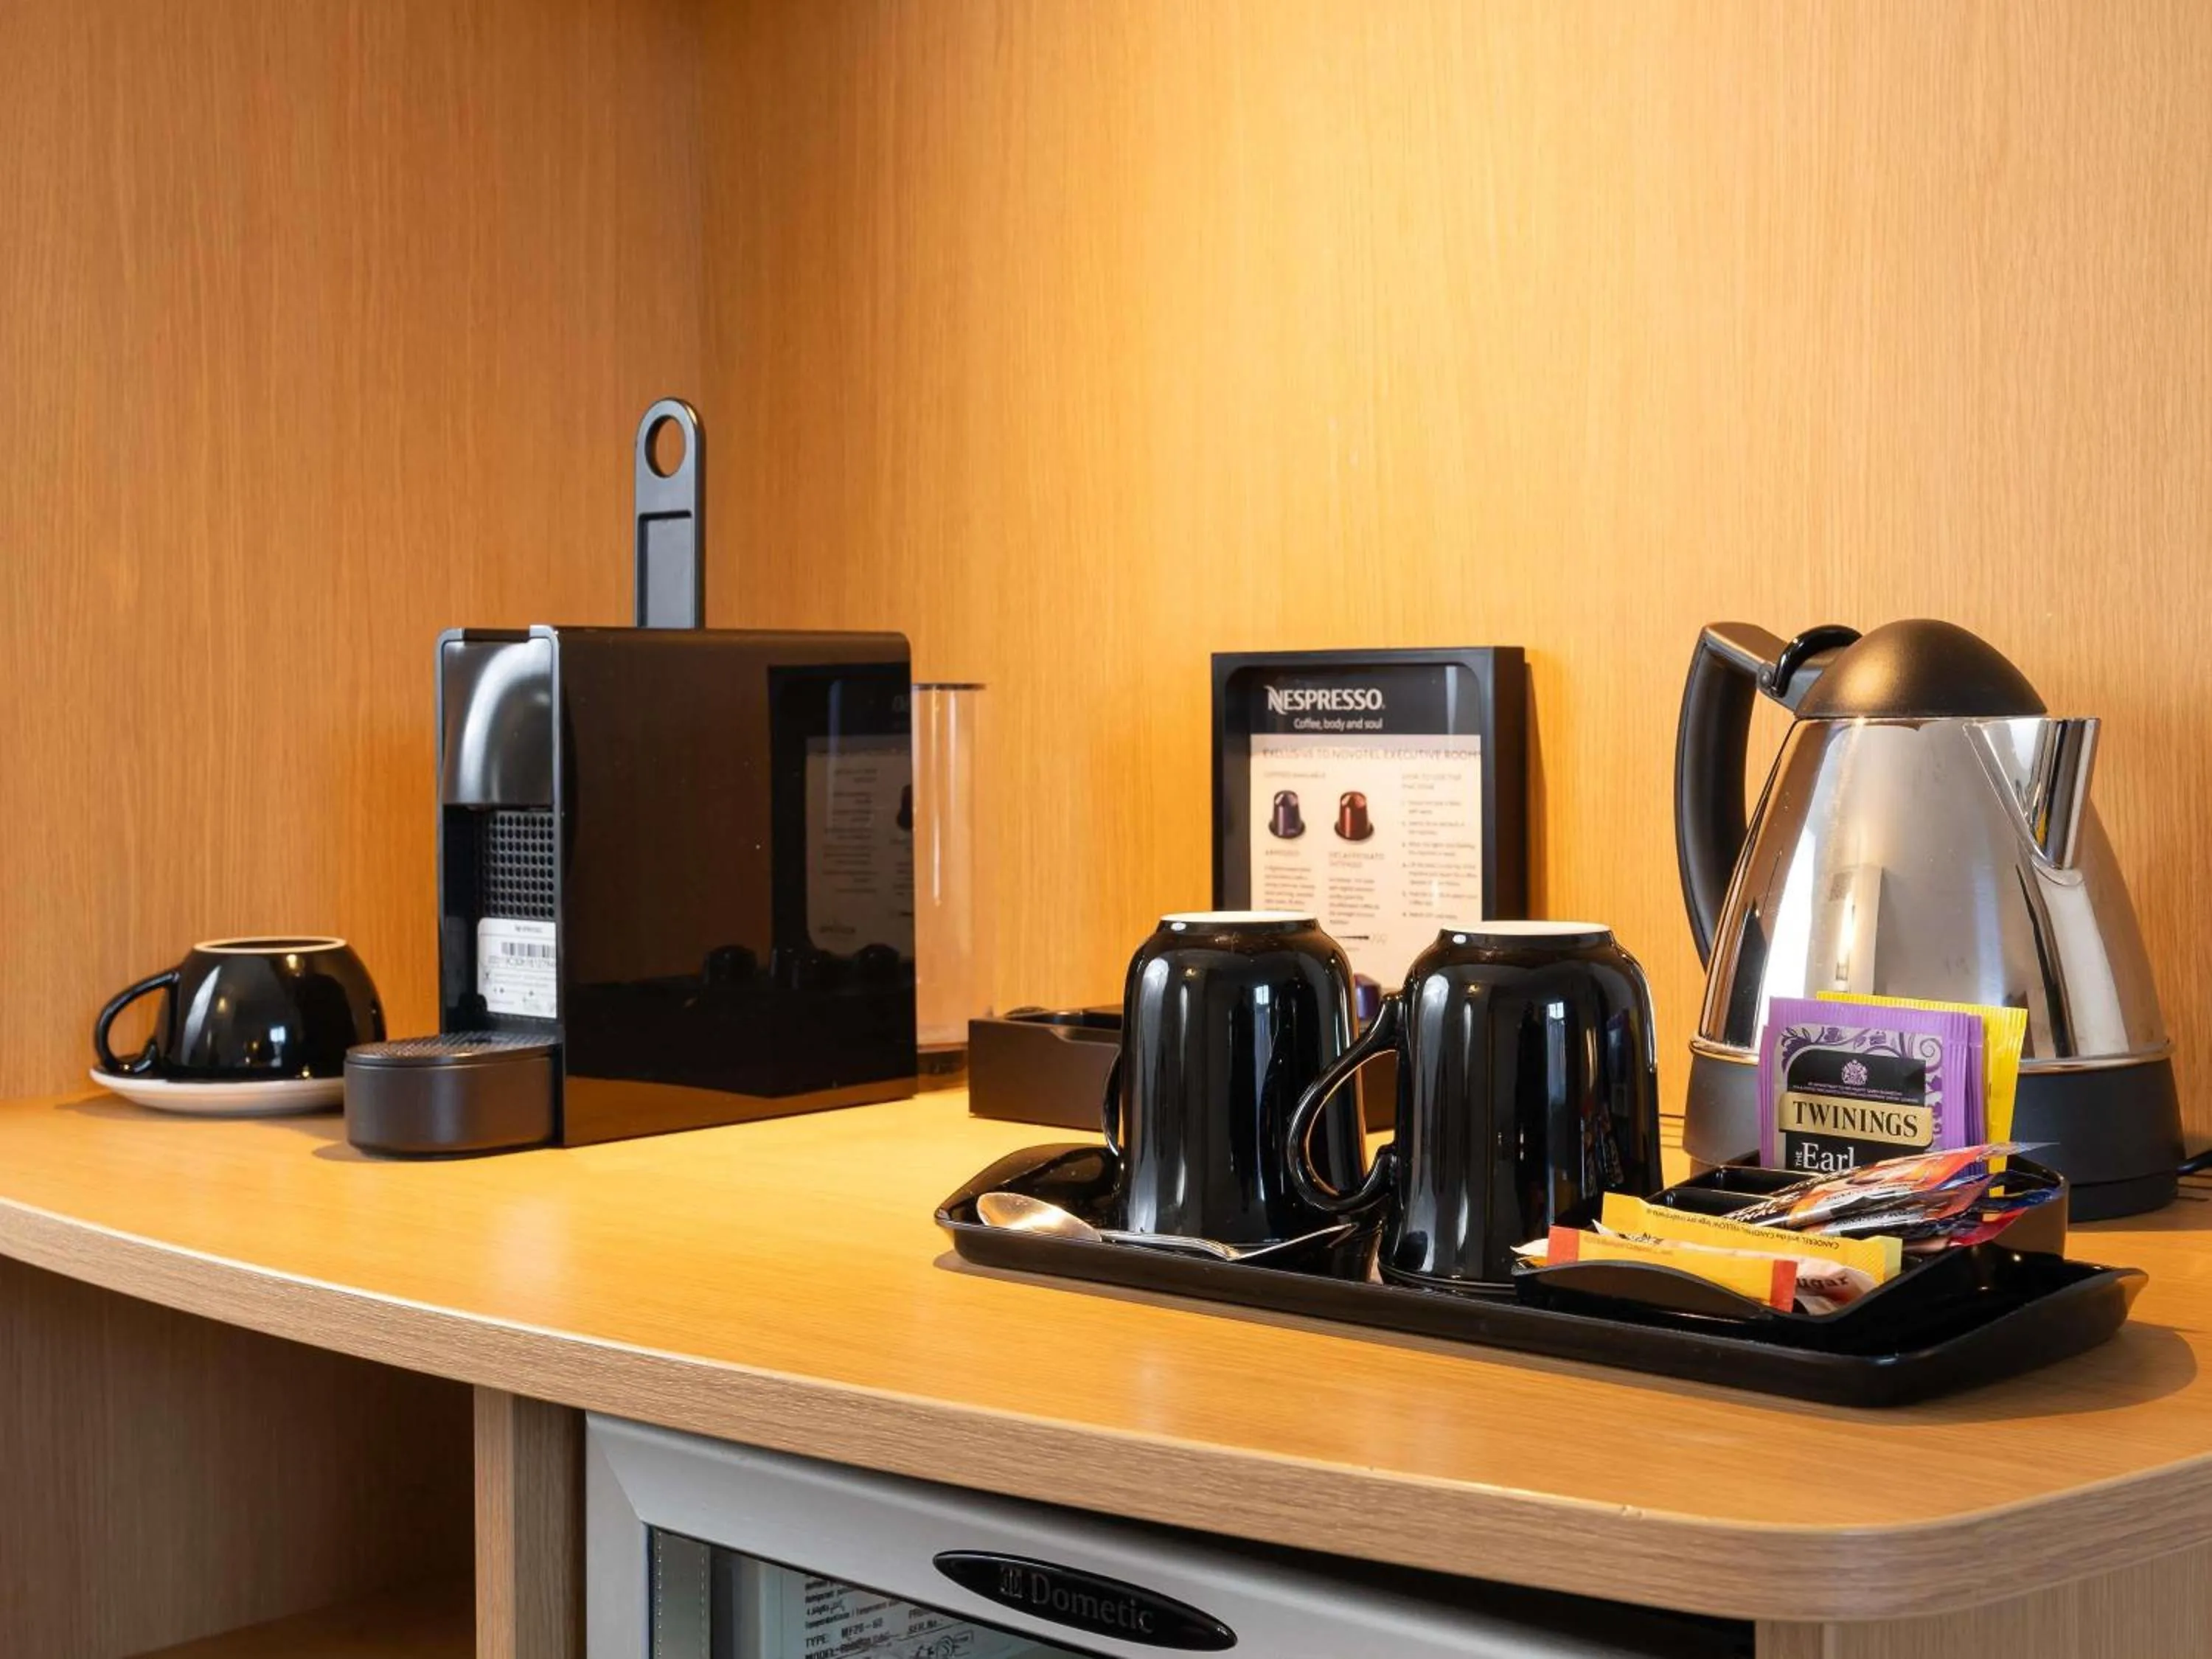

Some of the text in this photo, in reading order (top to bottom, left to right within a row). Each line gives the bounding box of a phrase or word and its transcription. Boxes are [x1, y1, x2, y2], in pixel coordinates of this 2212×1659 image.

[1265, 685, 1382, 714] NESPRESSO
[1293, 717, 1383, 732] Coffee, body and soul
[1793, 1100, 1918, 1138] TWININGS
[1794, 1150, 1804, 1167] THE
[1801, 1141, 1855, 1172] Earl
[1796, 1274, 1849, 1290] ugar
[1031, 1572, 1155, 1635] Dometic
